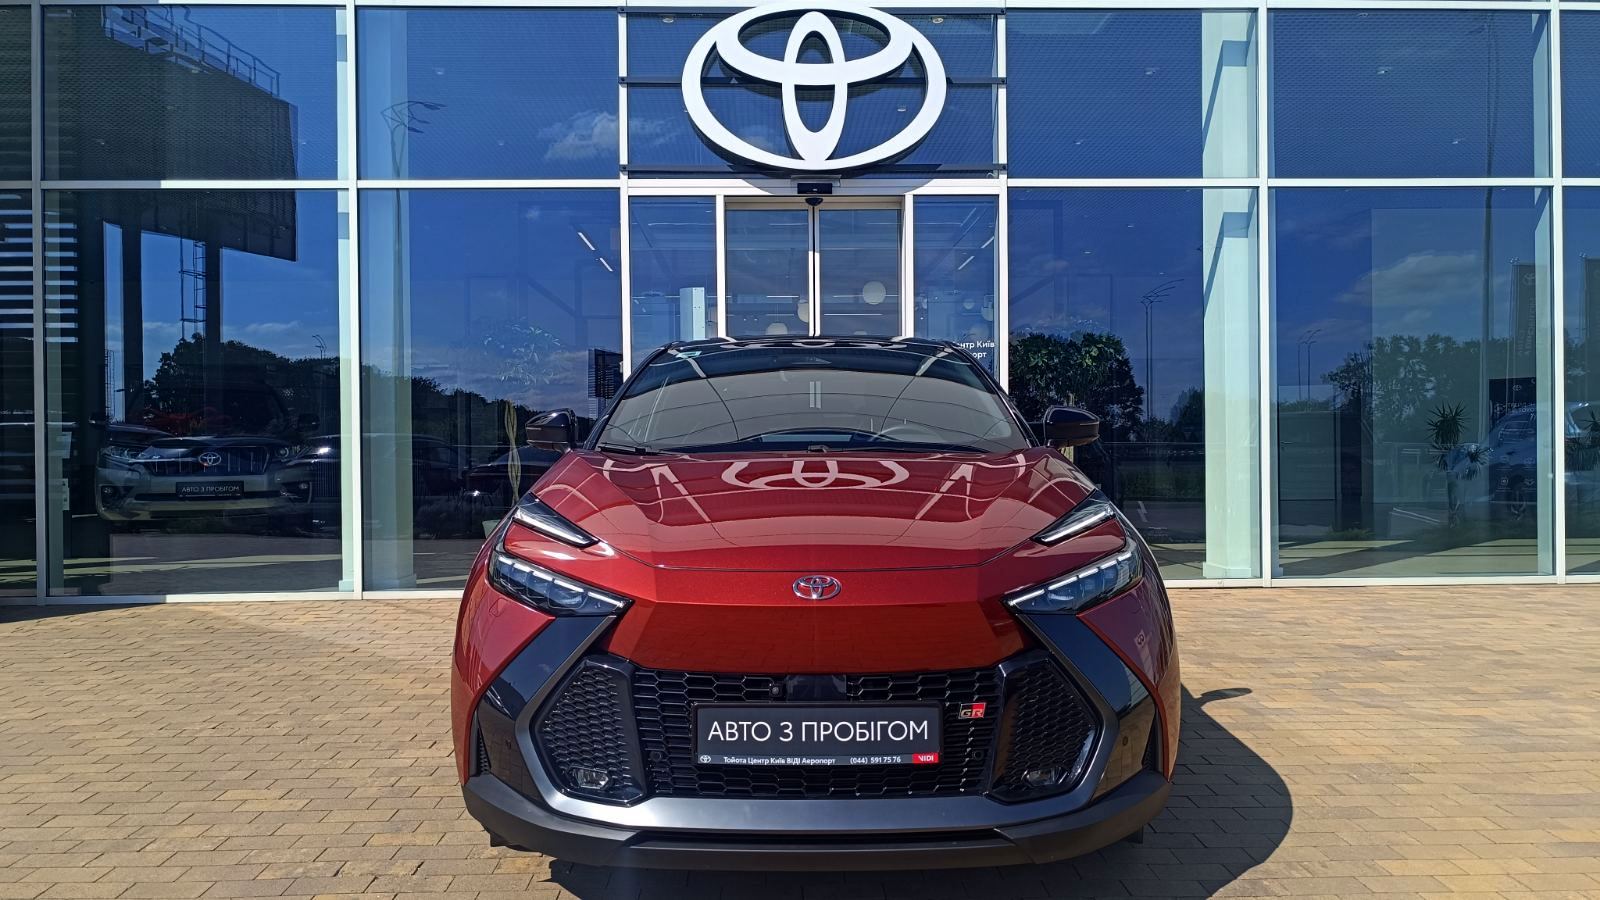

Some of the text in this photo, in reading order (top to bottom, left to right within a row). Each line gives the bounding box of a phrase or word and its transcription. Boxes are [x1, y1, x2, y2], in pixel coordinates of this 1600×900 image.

[976, 340, 995, 348] Київ
[960, 709, 983, 718] GR
[708, 720, 929, 742] АВТО З ПРОБІГОМ
[723, 756, 836, 765] Тойота Центр Київ ВІДІ Аеропорт
[850, 756, 868, 764] (044)
[870, 756, 883, 764] 591
